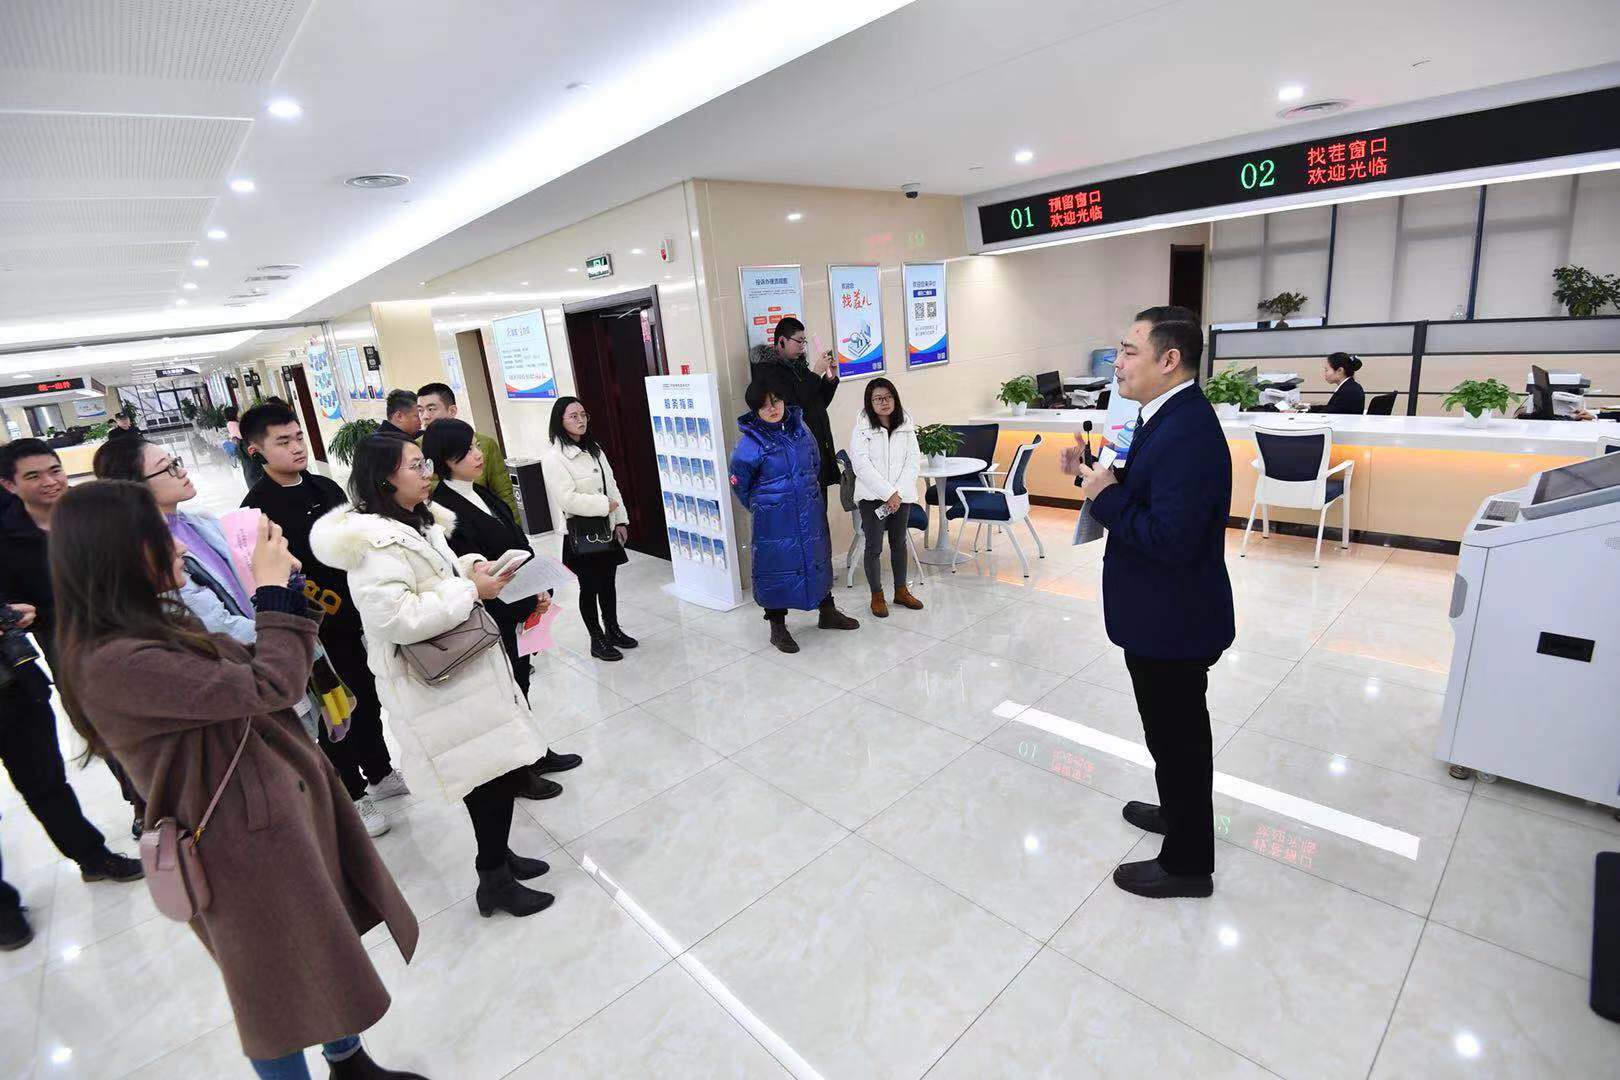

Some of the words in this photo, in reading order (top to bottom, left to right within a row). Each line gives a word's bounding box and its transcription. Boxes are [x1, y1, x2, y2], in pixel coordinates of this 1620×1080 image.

[1307, 137, 1387, 167] 找茬窗口
[1241, 159, 1275, 189] 02
[1307, 157, 1388, 184] 欢迎光临
[1048, 190, 1101, 213] 预留窗口
[1010, 206, 1034, 229] 01
[1050, 205, 1103, 227] 欢迎光临
